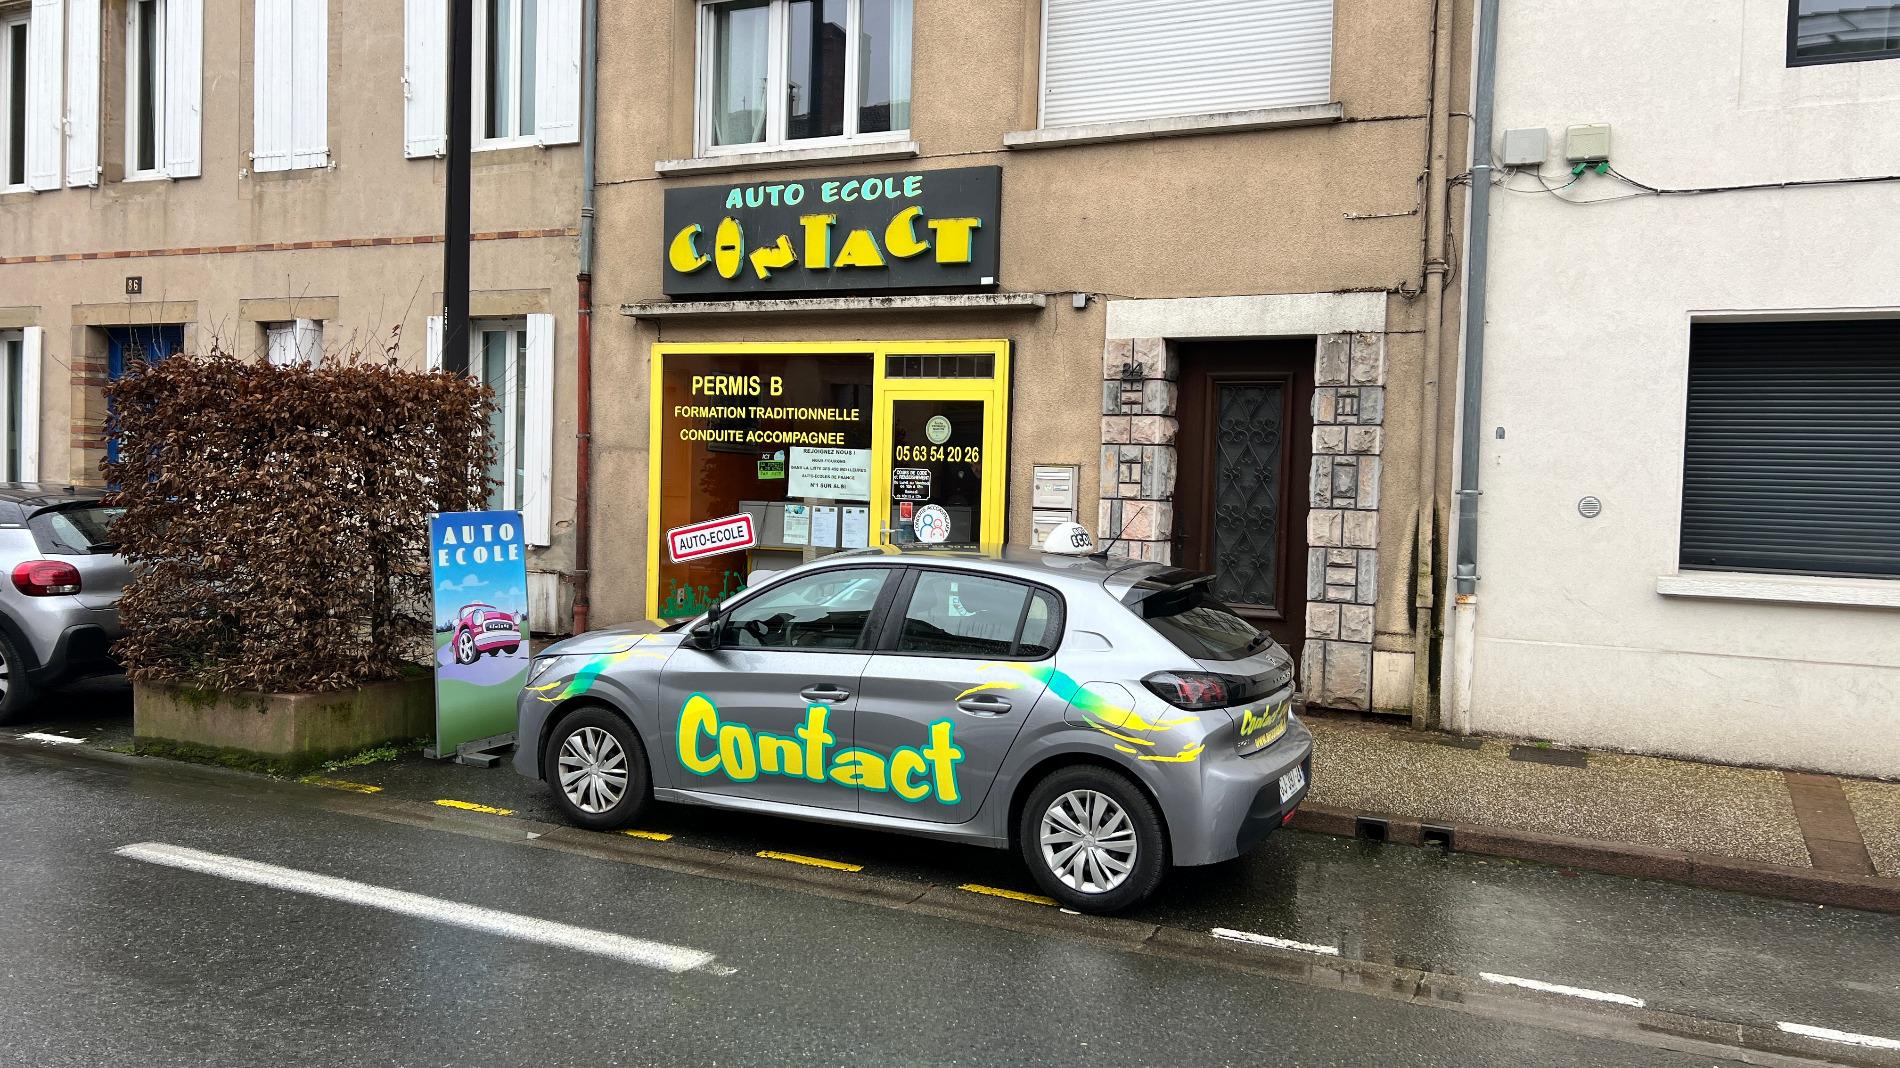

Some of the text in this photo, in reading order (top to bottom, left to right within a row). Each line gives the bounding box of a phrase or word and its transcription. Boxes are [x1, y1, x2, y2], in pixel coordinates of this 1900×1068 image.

[725, 175, 923, 209] AUTO ECOLE
[669, 205, 982, 279] CONTACT
[692, 376, 783, 396] PERMIS B
[674, 406, 860, 421] FORMATION TRADITIONNELLE
[680, 429, 845, 445] CONDUITE ACCOMPAGNEE
[896, 446, 979, 462] 05 63 54 20 26
[443, 523, 514, 545] AUTO
[680, 525, 745, 550] AUTO-ECOLE
[438, 544, 519, 567] ECOLE
[676, 692, 965, 804] Contact
